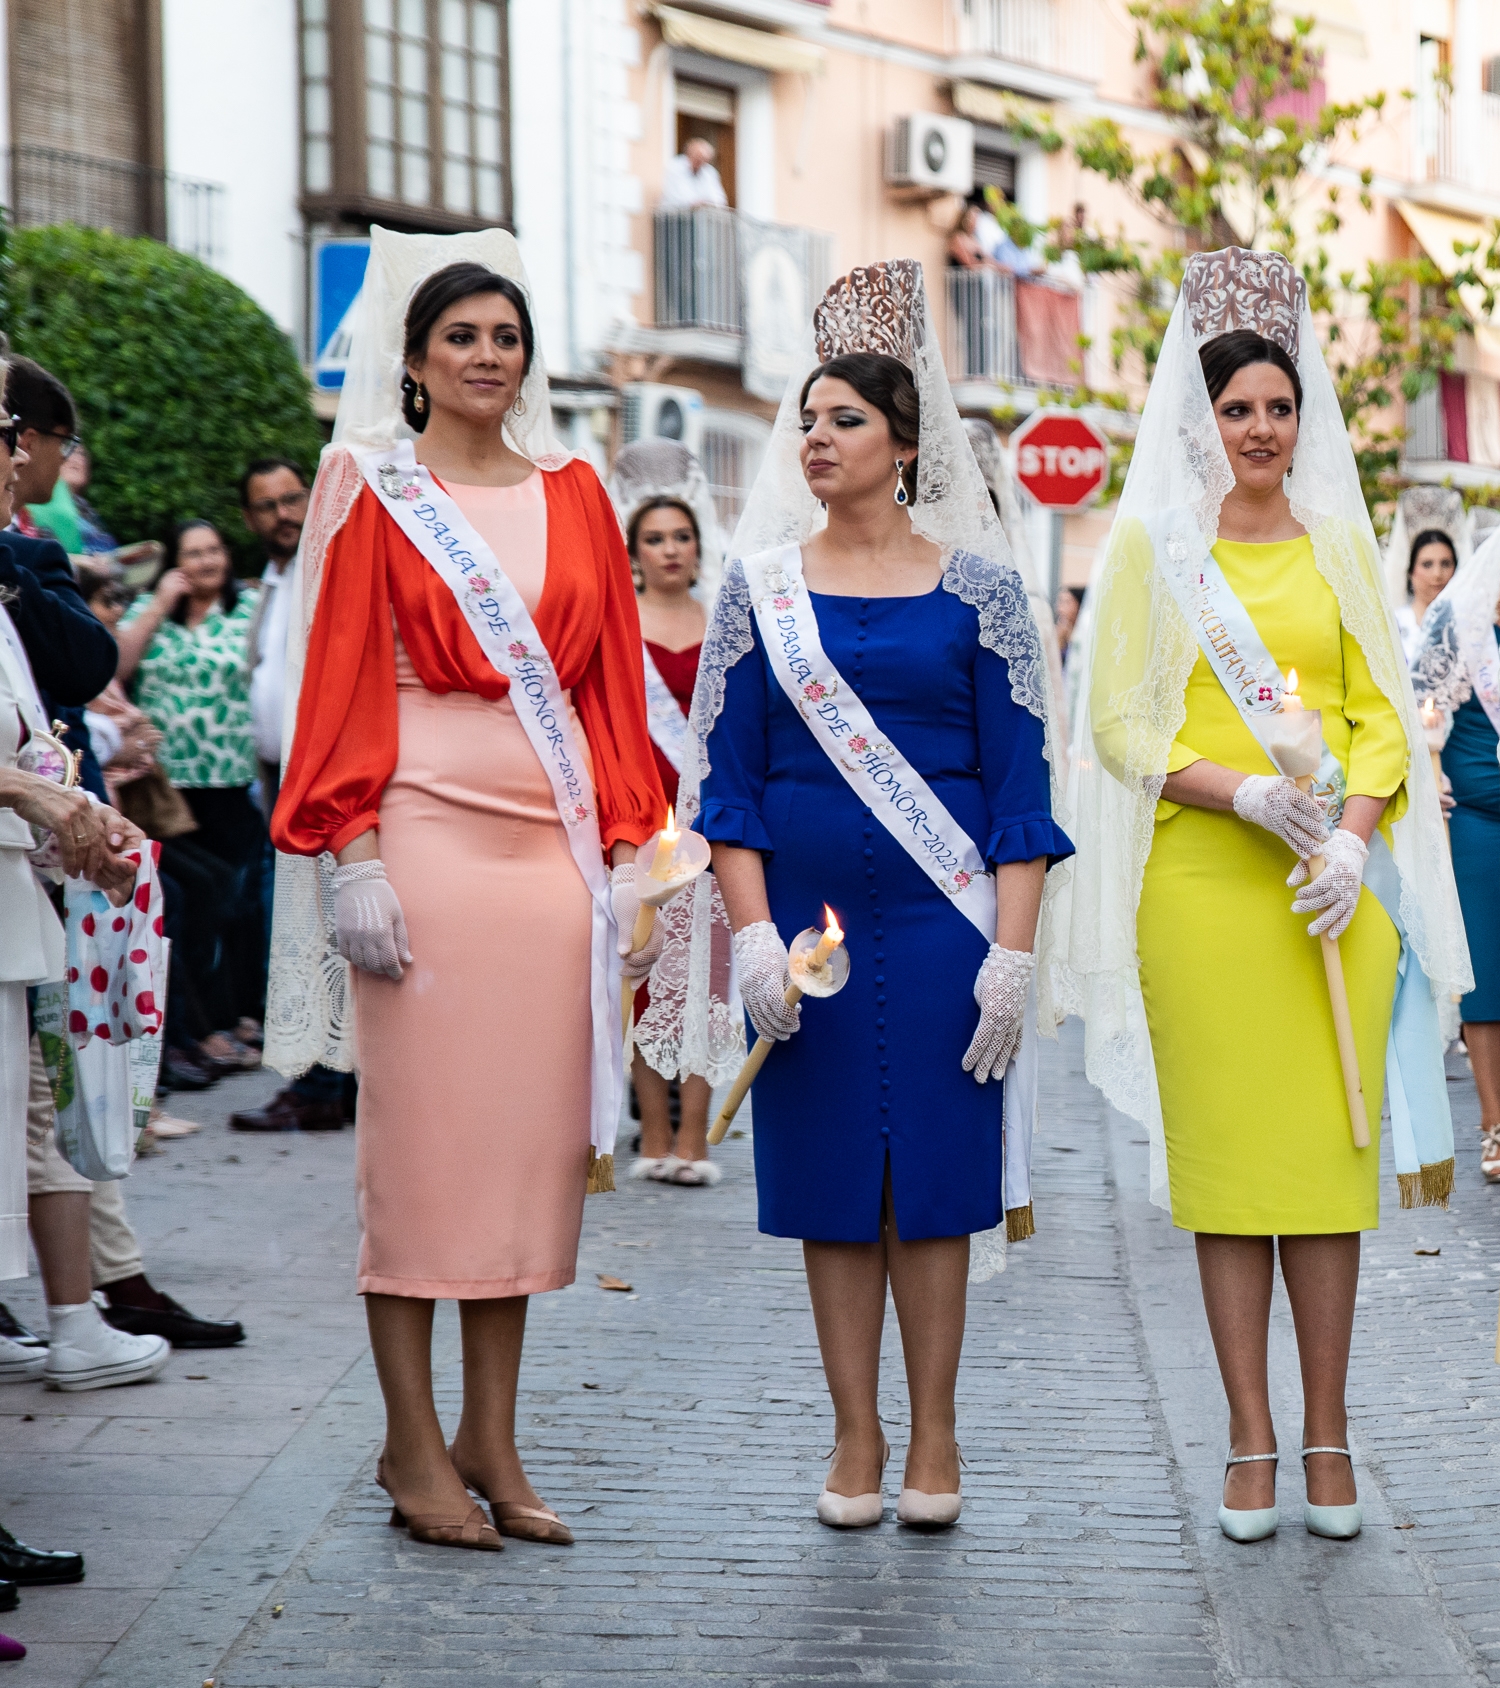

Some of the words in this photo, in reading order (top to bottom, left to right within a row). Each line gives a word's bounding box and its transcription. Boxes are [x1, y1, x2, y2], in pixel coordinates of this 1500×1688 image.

[1020, 445, 1106, 478] STOP
[412, 503, 478, 576] DAMA
[478, 597, 511, 636] DE
[515, 661, 582, 800] HONOR-2022
[776, 614, 814, 685] DAMA
[816, 702, 852, 738] DE
[857, 753, 959, 872] HONOR-2022
